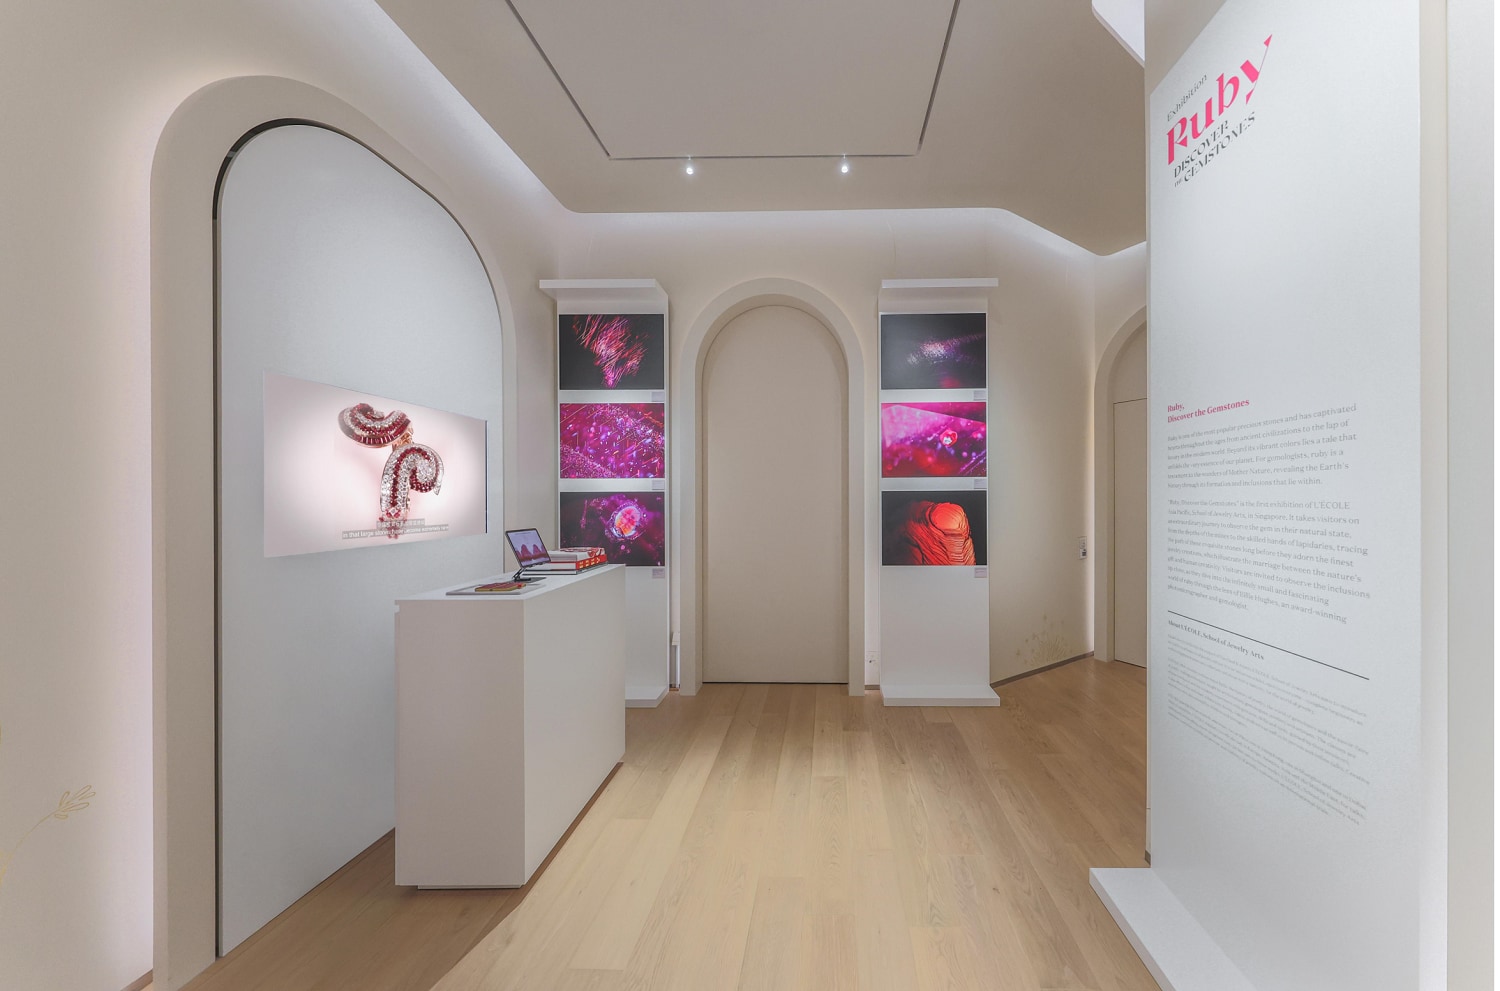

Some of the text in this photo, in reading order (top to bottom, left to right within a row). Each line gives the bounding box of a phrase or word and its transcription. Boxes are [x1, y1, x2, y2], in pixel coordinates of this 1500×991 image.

[1166, 34, 1273, 165] Ruby
[1167, 74, 1208, 122] Exhibition
[1174, 119, 1229, 178] DISCOVER
[1183, 111, 1256, 182] GEMSTONES
[1167, 403, 1185, 412] Ruby,
[1167, 399, 1250, 423] Discover the Gemstones
[1262, 417, 1284, 425] stones
[1284, 413, 1298, 421] and
[1313, 403, 1357, 417] captivated
[1239, 432, 1261, 441] ancient
[1262, 427, 1301, 438] civilizations
[1312, 423, 1325, 431] the
[1326, 422, 1339, 430] lap
[1256, 441, 1279, 450] vibrant
[1322, 435, 1337, 443] tale
[1338, 432, 1357, 441] that
[1267, 452, 1309, 463] gemologists,
[1311, 450, 1328, 459] ruby
[1249, 467, 1273, 475] Nature,
[1273, 465, 1304, 473] revealing
[1320, 462, 1349, 470] Earth's
[1255, 513, 1288, 522] Singapore.
[1296, 514, 1315, 522] takes
[1317, 515, 1347, 523] visitors
[1227, 522, 1248, 530] observe
[1281, 526, 1298, 534] their
[1299, 528, 1327, 536] natural
[1328, 530, 1352, 540] state,
[1247, 535, 1266, 543] skilled
[1266, 537, 1287, 545] hands
[1295, 540, 1335, 552] lapidaries,
[1337, 544, 1369, 556] tracing
[1242, 546, 1255, 555] long
[1255, 547, 1276, 556] before
[1277, 550, 1292, 560] they
[1293, 553, 1314, 561] adorn
[1316, 555, 1329, 563] the
[1330, 557, 1354, 567] finest
[1253, 561, 1281, 571] marriage
[1282, 564, 1311, 575] between
[1312, 569, 1325, 577] the
[1327, 572, 1362, 583] nature's
[1254, 571, 1275, 581] invited
[1284, 577, 1312, 587] observe
[1313, 582, 1326, 590] the
[1327, 584, 1370, 598] inclusions
[1258, 584, 1274, 592] small
[1288, 589, 1329, 605] fascinating
[1255, 594, 1280, 607] Hughes,
[1291, 604, 1347, 624] award-winning
[1227, 640, 1249, 655] Jewelry
[1251, 648, 1264, 659] Arts
